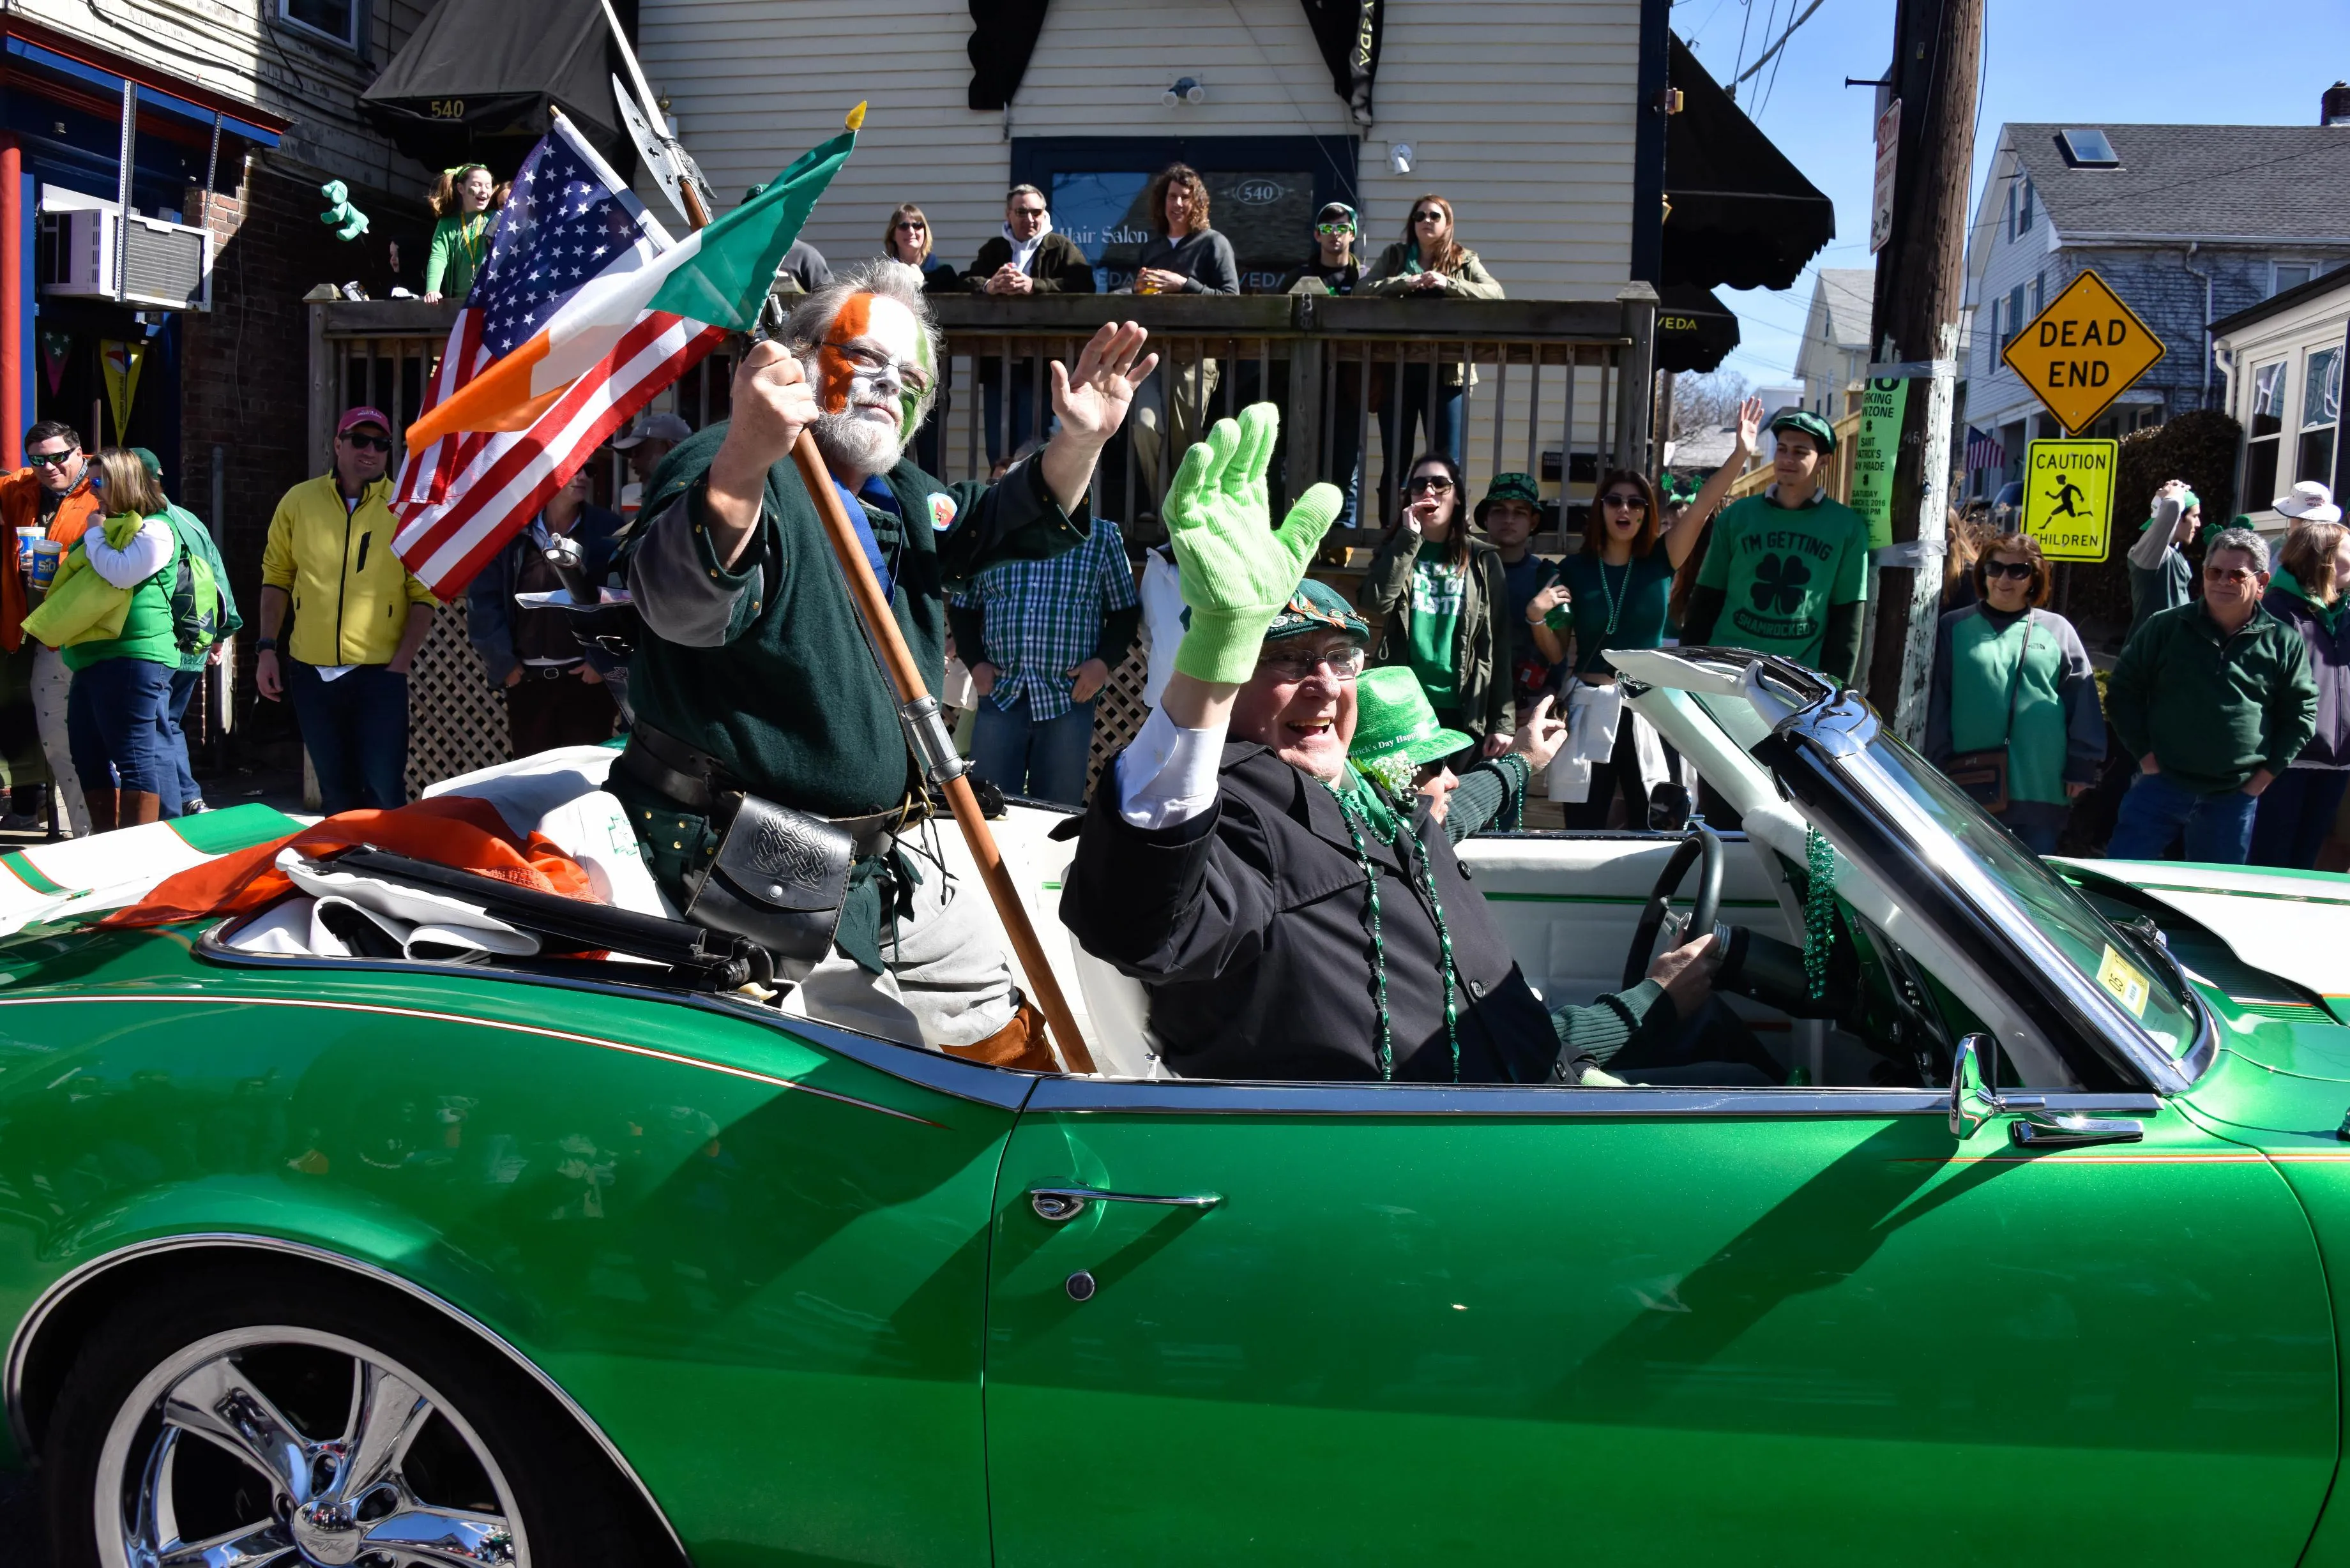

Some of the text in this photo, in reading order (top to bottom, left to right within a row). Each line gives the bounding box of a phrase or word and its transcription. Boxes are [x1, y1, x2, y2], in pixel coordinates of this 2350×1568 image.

[431, 100, 464, 118] 540
[1243, 186, 1273, 200] 540
[1060, 225, 1148, 244] Hair Salon
[2040, 319, 2126, 347] DEAD
[2049, 361, 2109, 387] END
[2036, 453, 2107, 469] CAUTION
[1740, 531, 1833, 561] I'M GETTING
[2031, 533, 2098, 547] CHILDREN
[1738, 613, 1811, 637] SHAMROCKED
[1378, 739, 1394, 750] Day
[2109, 973, 2123, 992] 05
